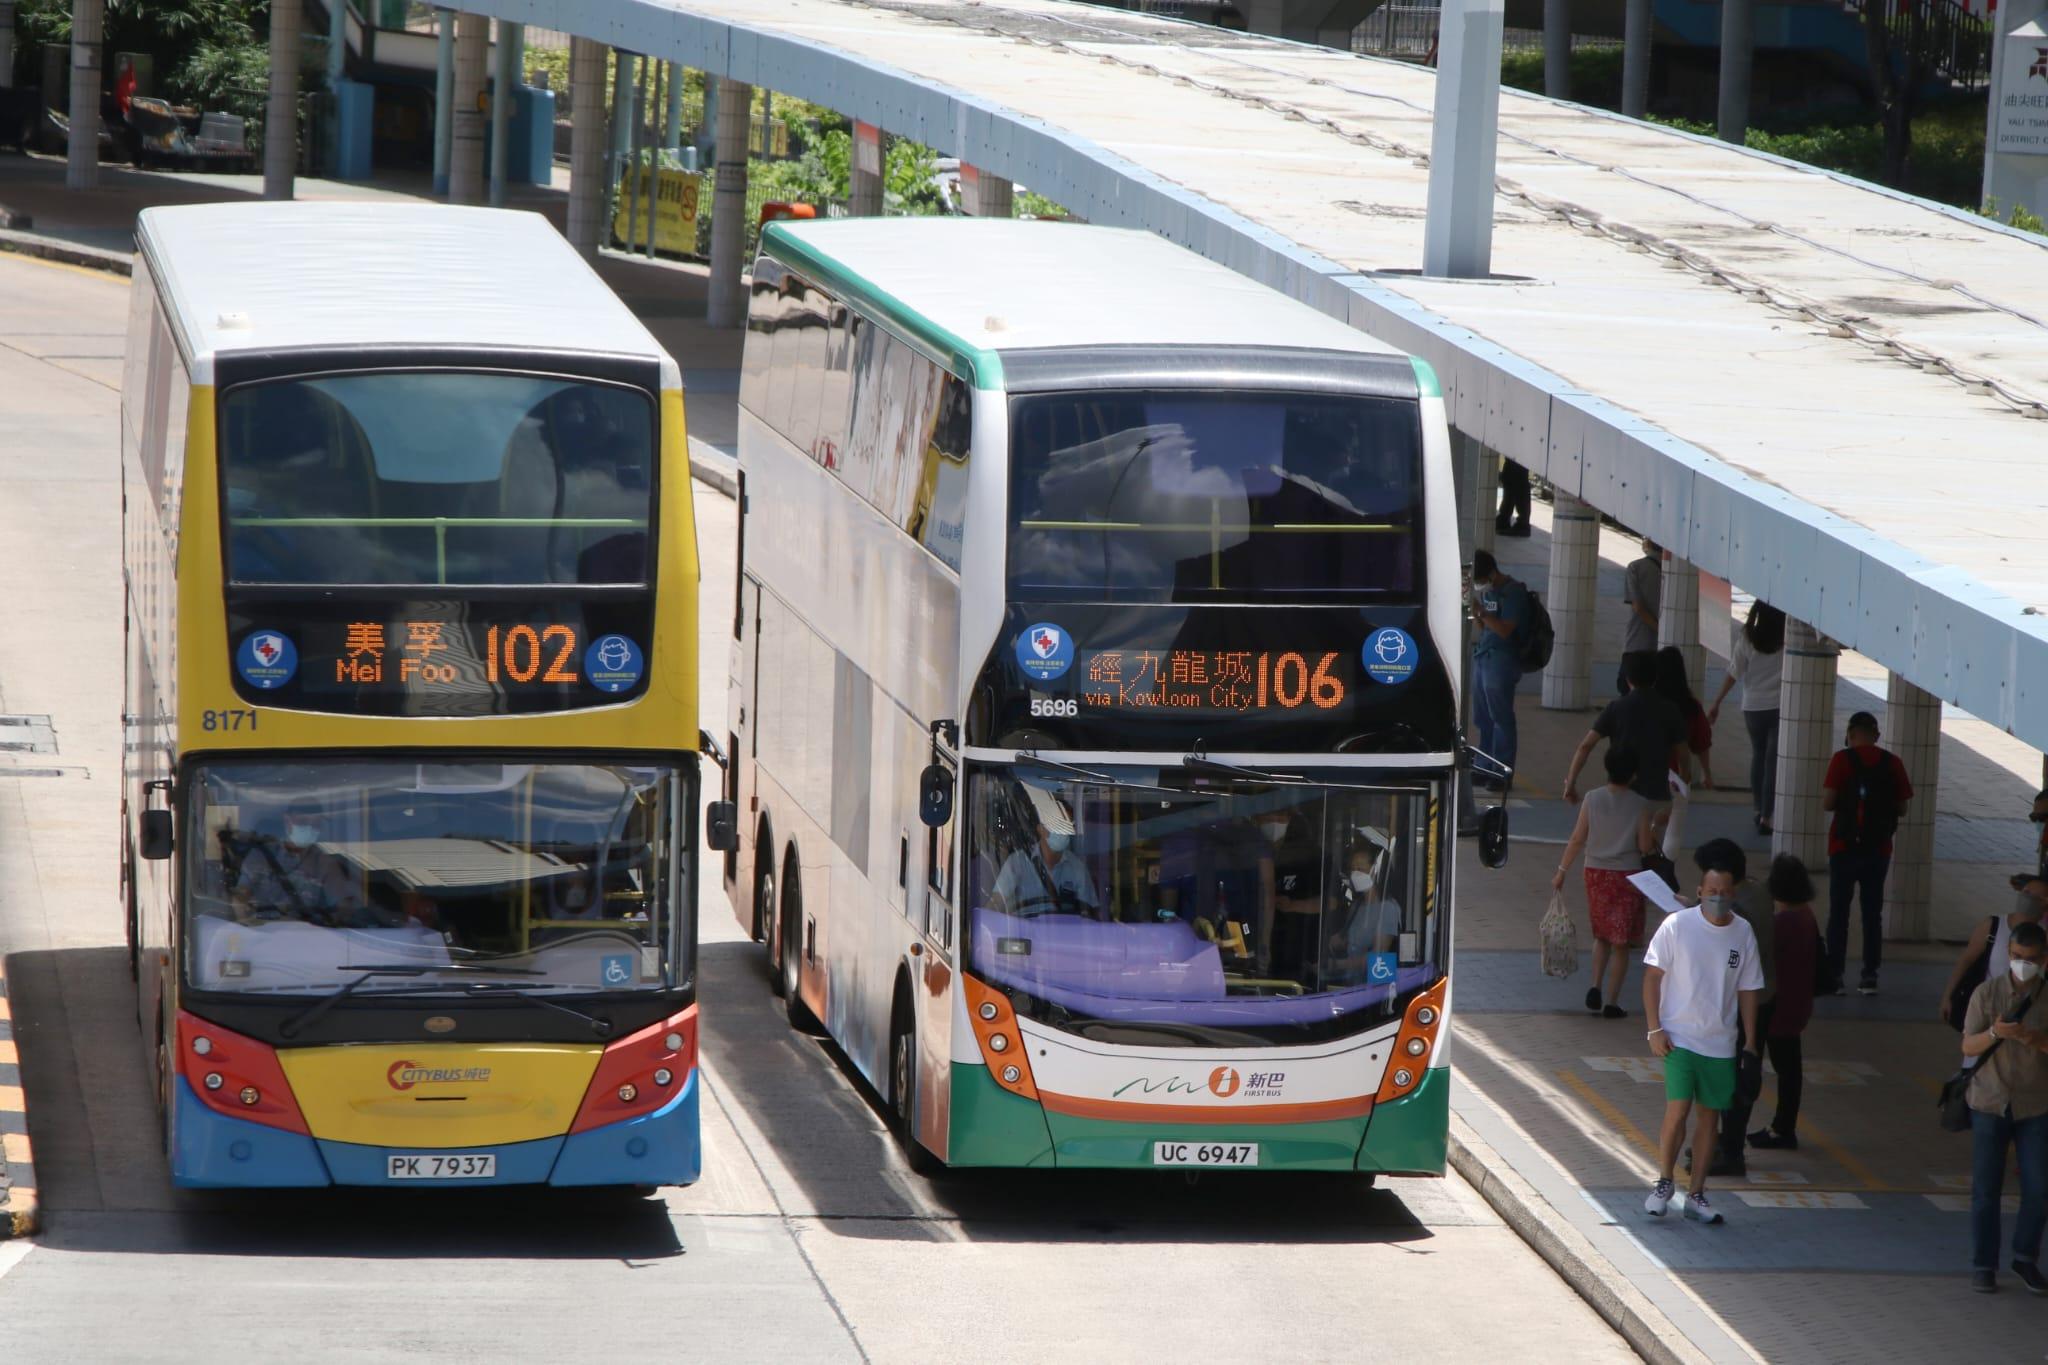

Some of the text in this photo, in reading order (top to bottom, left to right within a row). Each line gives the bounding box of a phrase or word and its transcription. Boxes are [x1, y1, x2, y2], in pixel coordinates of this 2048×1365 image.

[345, 622, 448, 658] 美孚
[487, 624, 578, 683] 102
[336, 658, 457, 683] Mei Foo
[1088, 651, 1252, 684] 經九龍城
[1257, 651, 1345, 709] 106
[1030, 699, 1078, 717] 5696
[1085, 683, 1253, 711] via Kowloon City
[202, 709, 257, 731] 8171
[1246, 1072, 1286, 1089] 新巴
[391, 1157, 491, 1176] PK 7937
[1161, 1144, 1252, 1164] UC 6947
